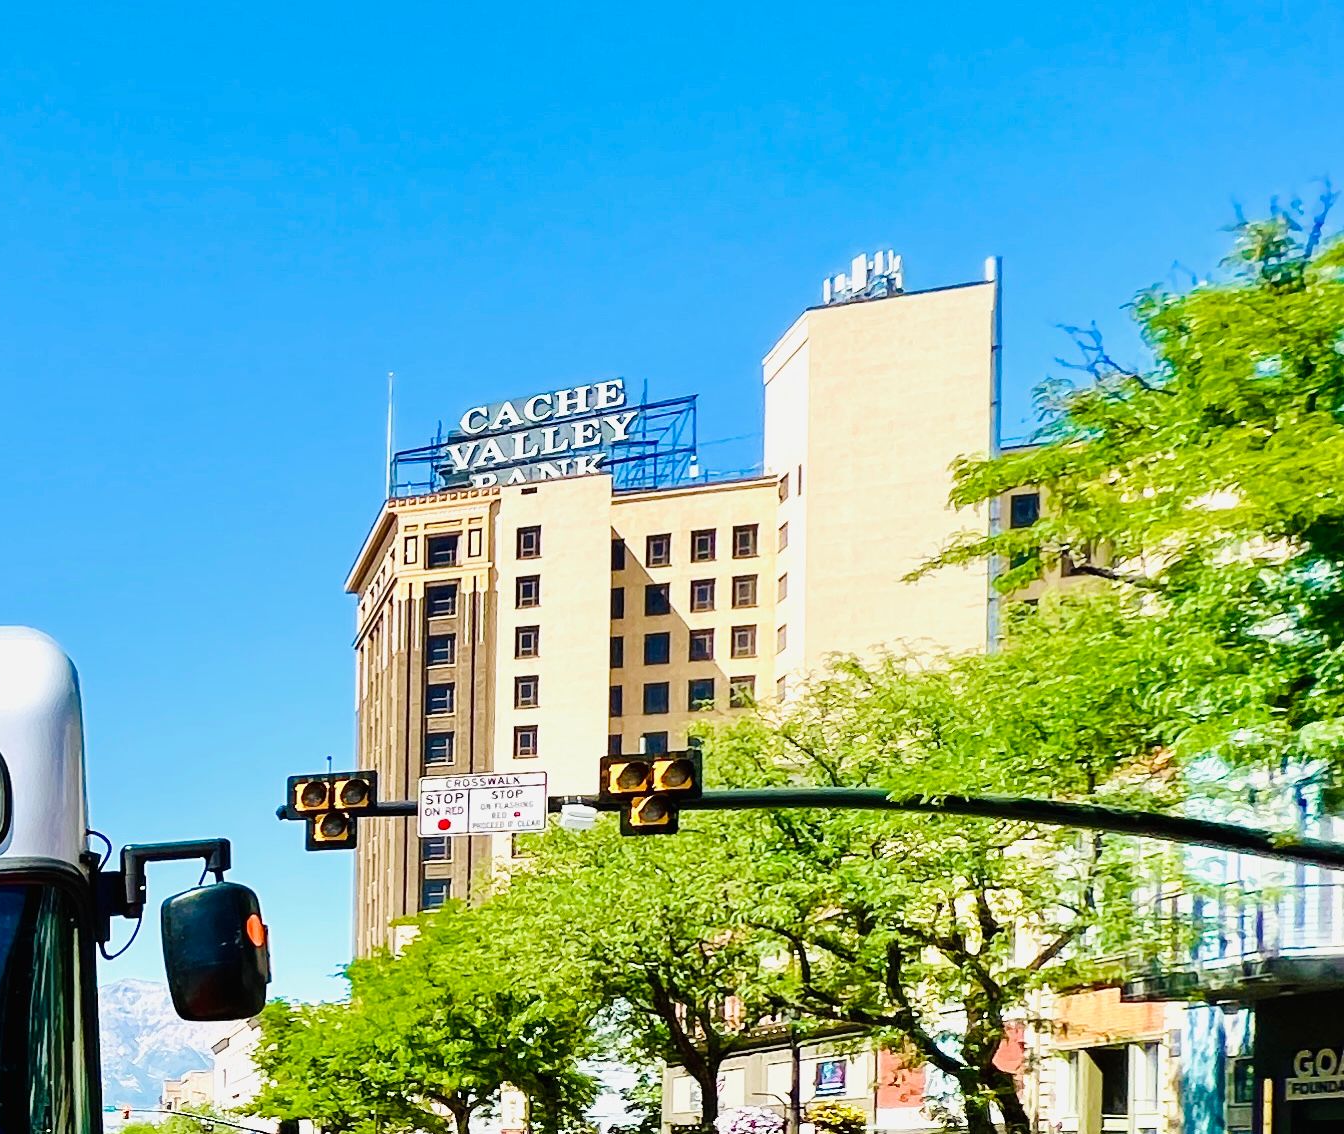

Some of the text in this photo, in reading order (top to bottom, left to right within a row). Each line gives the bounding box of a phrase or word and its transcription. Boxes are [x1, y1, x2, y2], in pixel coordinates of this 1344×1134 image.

[460, 379, 625, 434] CACHE
[446, 411, 638, 471] VALLEY
[446, 776, 520, 788] CROSSWALK
[426, 793, 464, 805] STOP
[491, 790, 524, 799] STOP
[424, 807, 464, 816] ON RED
